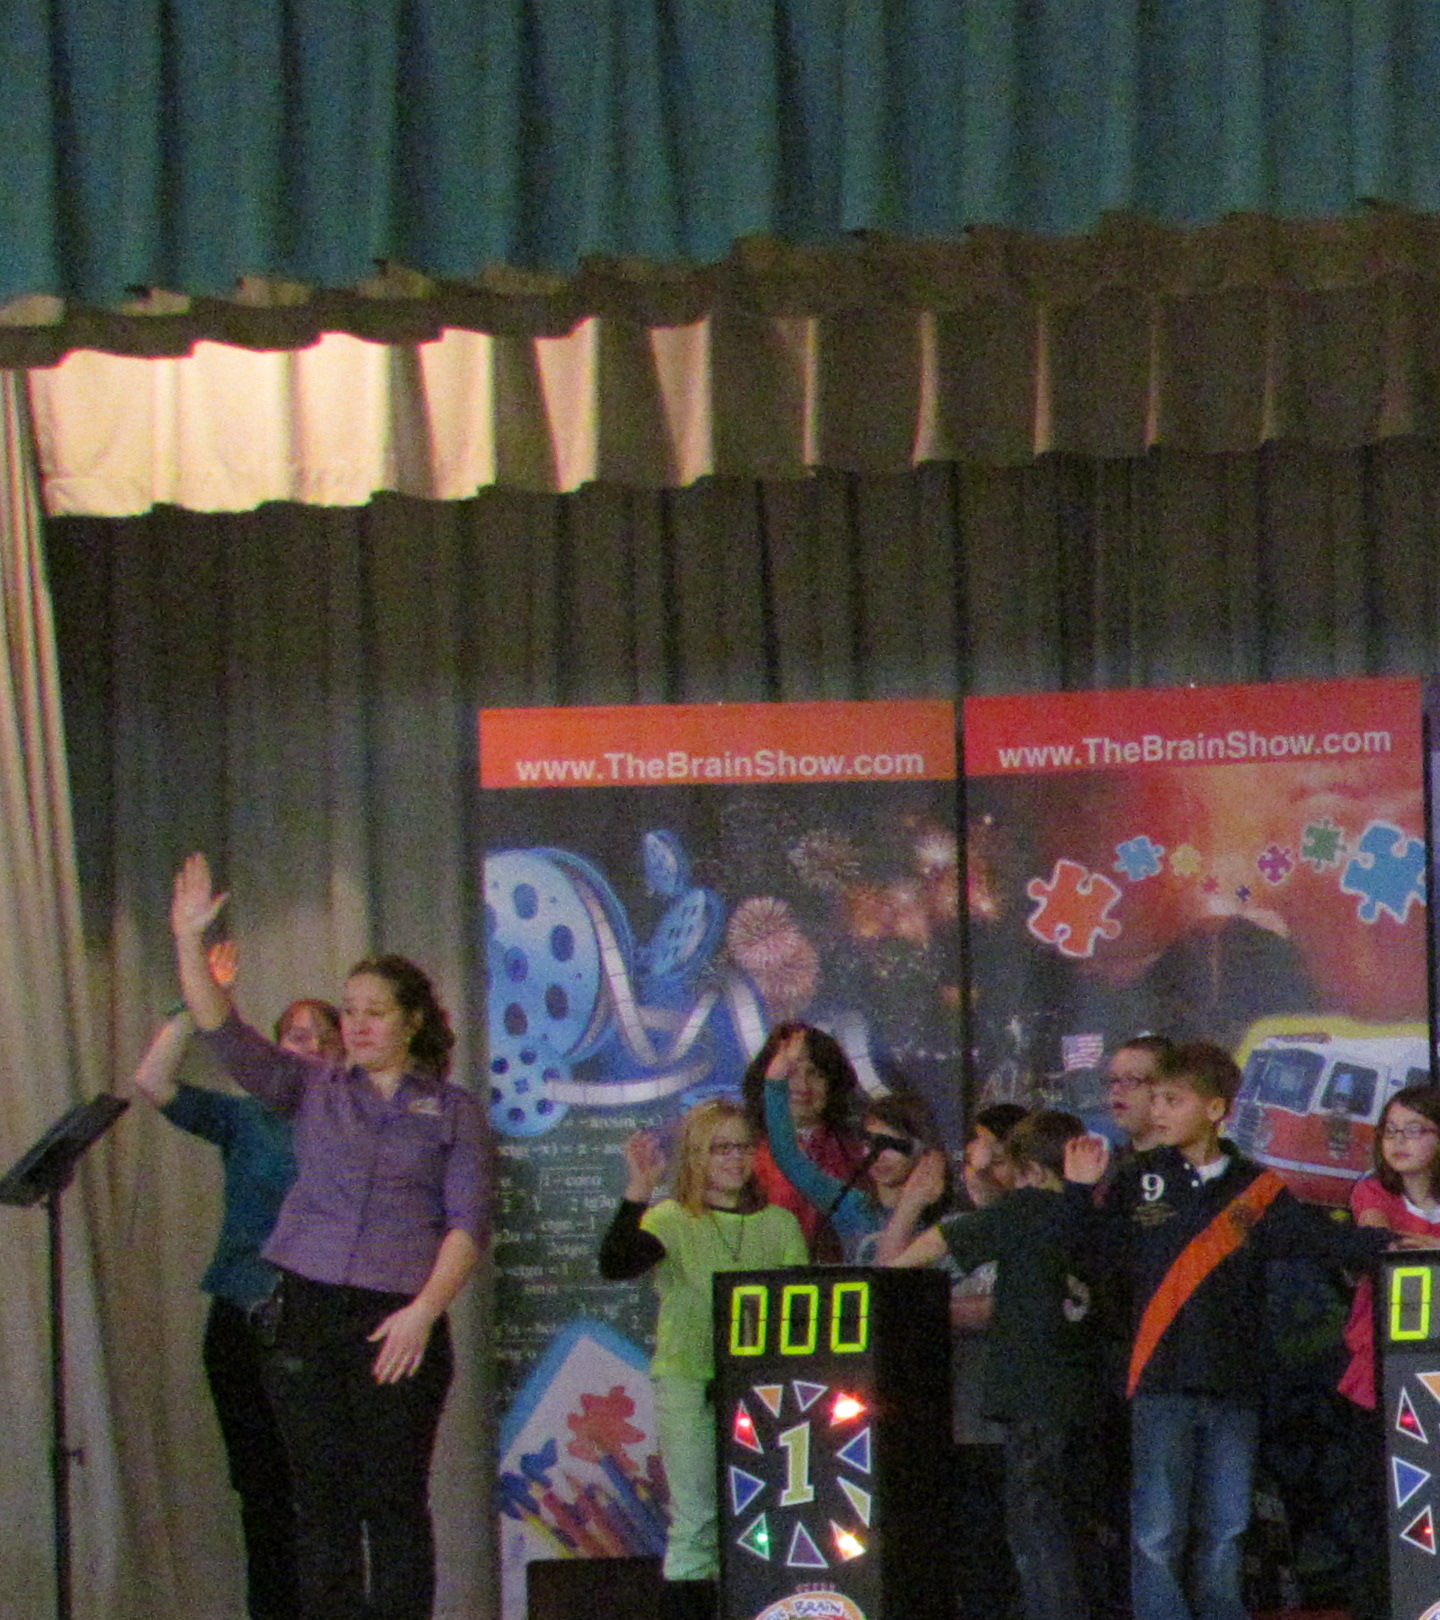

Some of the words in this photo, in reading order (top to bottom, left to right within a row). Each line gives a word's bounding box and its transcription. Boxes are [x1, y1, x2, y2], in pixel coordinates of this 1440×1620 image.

[516, 749, 925, 782] www.TheBrainShow.com
[997, 729, 1391, 768] www.TheBrainShow.com
[1141, 1173, 1165, 1201] 9
[777, 1421, 814, 1507] 1
